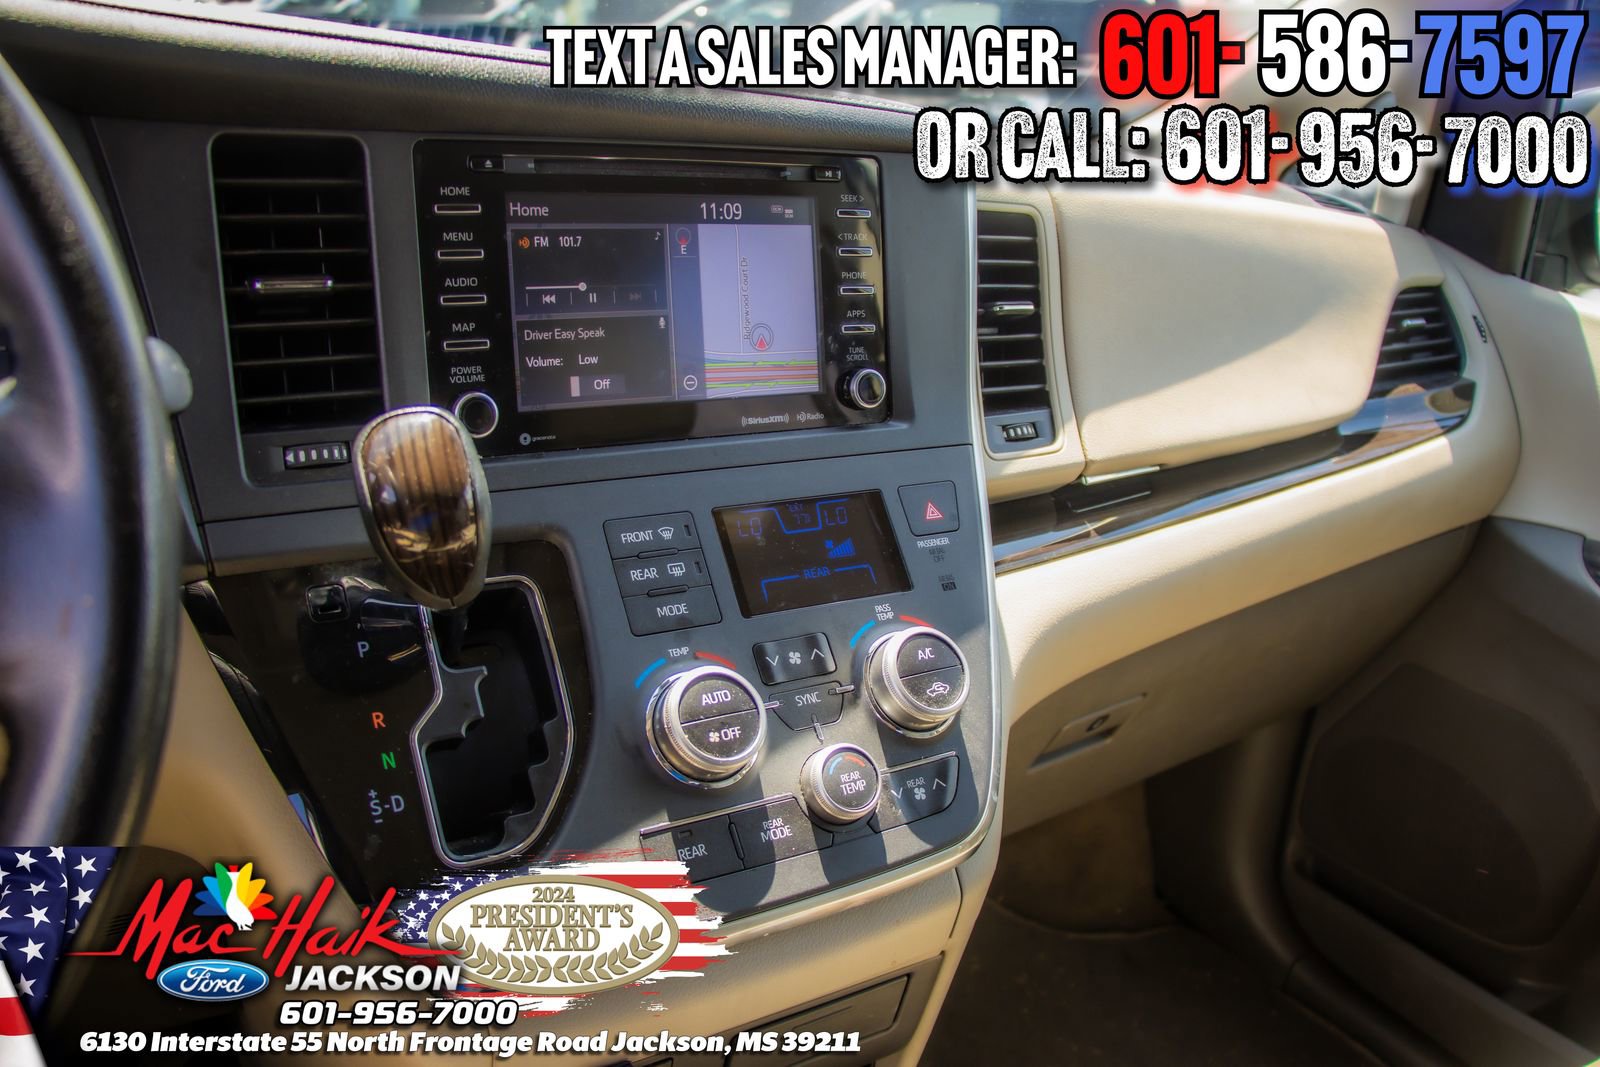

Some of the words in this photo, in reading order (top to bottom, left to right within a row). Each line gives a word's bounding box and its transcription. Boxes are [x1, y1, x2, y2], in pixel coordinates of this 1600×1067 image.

[440, 186, 471, 197] HOME
[840, 194, 858, 203] SEEK
[509, 202, 550, 217] Home
[700, 202, 743, 220] 11:09
[443, 231, 474, 242] MENU
[534, 236, 549, 248] FM
[558, 236, 583, 248] 101.7
[680, 245, 688, 255] E
[740, 256, 749, 267] Dr
[444, 277, 479, 288] AUDIO
[741, 269, 749, 293] Court
[841, 271, 867, 280] PHONE
[846, 310, 867, 319] APPS
[451, 322, 476, 333] MAP
[524, 328, 553, 341] Driver
[554, 327, 577, 341] Easy
[577, 326, 606, 340] Speak
[848, 346, 866, 354] TUNE
[525, 355, 564, 368] Volume:
[578, 353, 599, 366] Low
[845, 353, 870, 362] SCROLL
[450, 365, 483, 376] POWER
[449, 374, 486, 385] VOLUME
[593, 378, 612, 390] Off
[620, 529, 655, 545] FRONT
[916, 537, 951, 549] PASSENGER
[630, 567, 660, 582] REAR
[803, 566, 832, 580] REAR
[656, 602, 690, 618] MODE
[874, 603, 892, 613] PASS
[876, 611, 895, 622] TEMP
[356, 640, 371, 659] P
[667, 646, 690, 658] TEMP
[917, 647, 936, 661] A/C
[701, 689, 732, 707] AUTO
[794, 691, 823, 708] SYNC
[371, 711, 387, 730] R
[720, 725, 742, 742] OFF
[380, 751, 397, 770] N
[839, 770, 862, 784] REAR
[906, 776, 927, 789] REAR
[838, 779, 867, 797] TEMP
[762, 817, 784, 831] REAR
[759, 824, 793, 843] MODE
[677, 843, 709, 862] REAR
